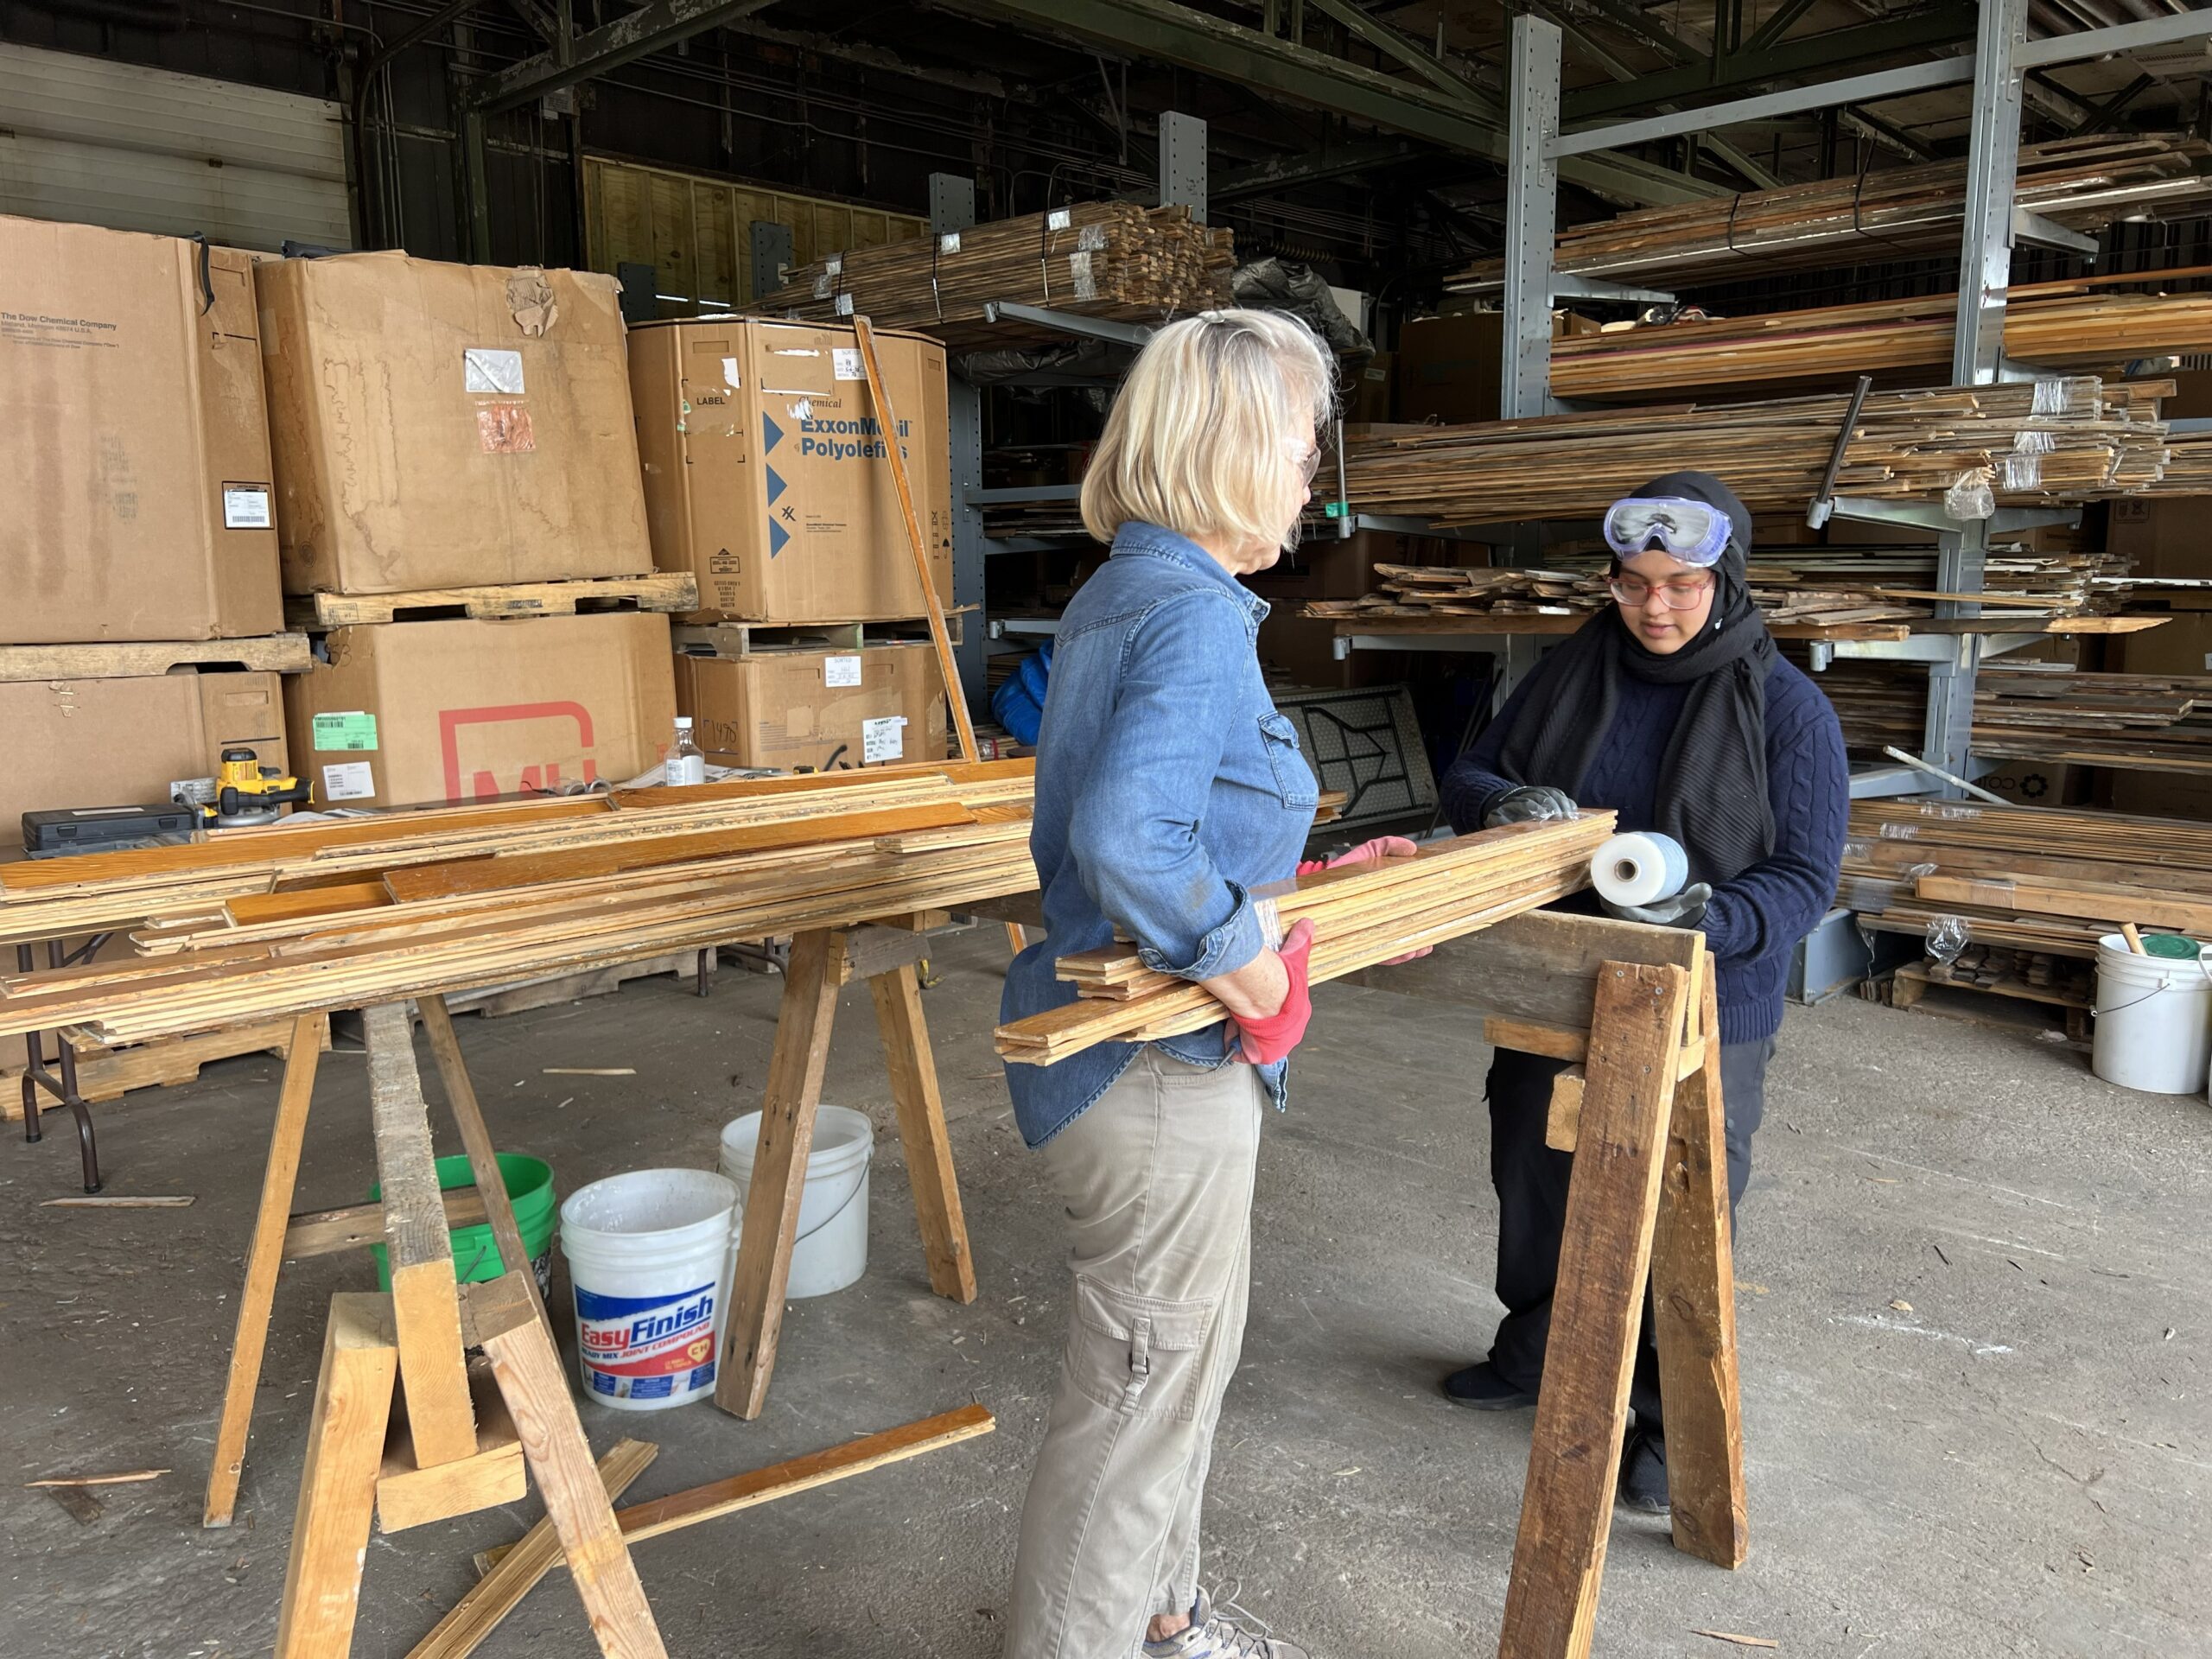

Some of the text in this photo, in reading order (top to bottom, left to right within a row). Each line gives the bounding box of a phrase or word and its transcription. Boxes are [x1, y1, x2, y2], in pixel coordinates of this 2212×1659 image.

[1, 312, 118, 331] The Dow Chemical Company
[696, 397, 726, 405] LABEL
[801, 416, 909, 437] ExxonMil
[802, 437, 907, 461] Polyolefis
[620, 1345, 652, 1358] JOINT
[652, 1321, 710, 1350] COMPOUND
